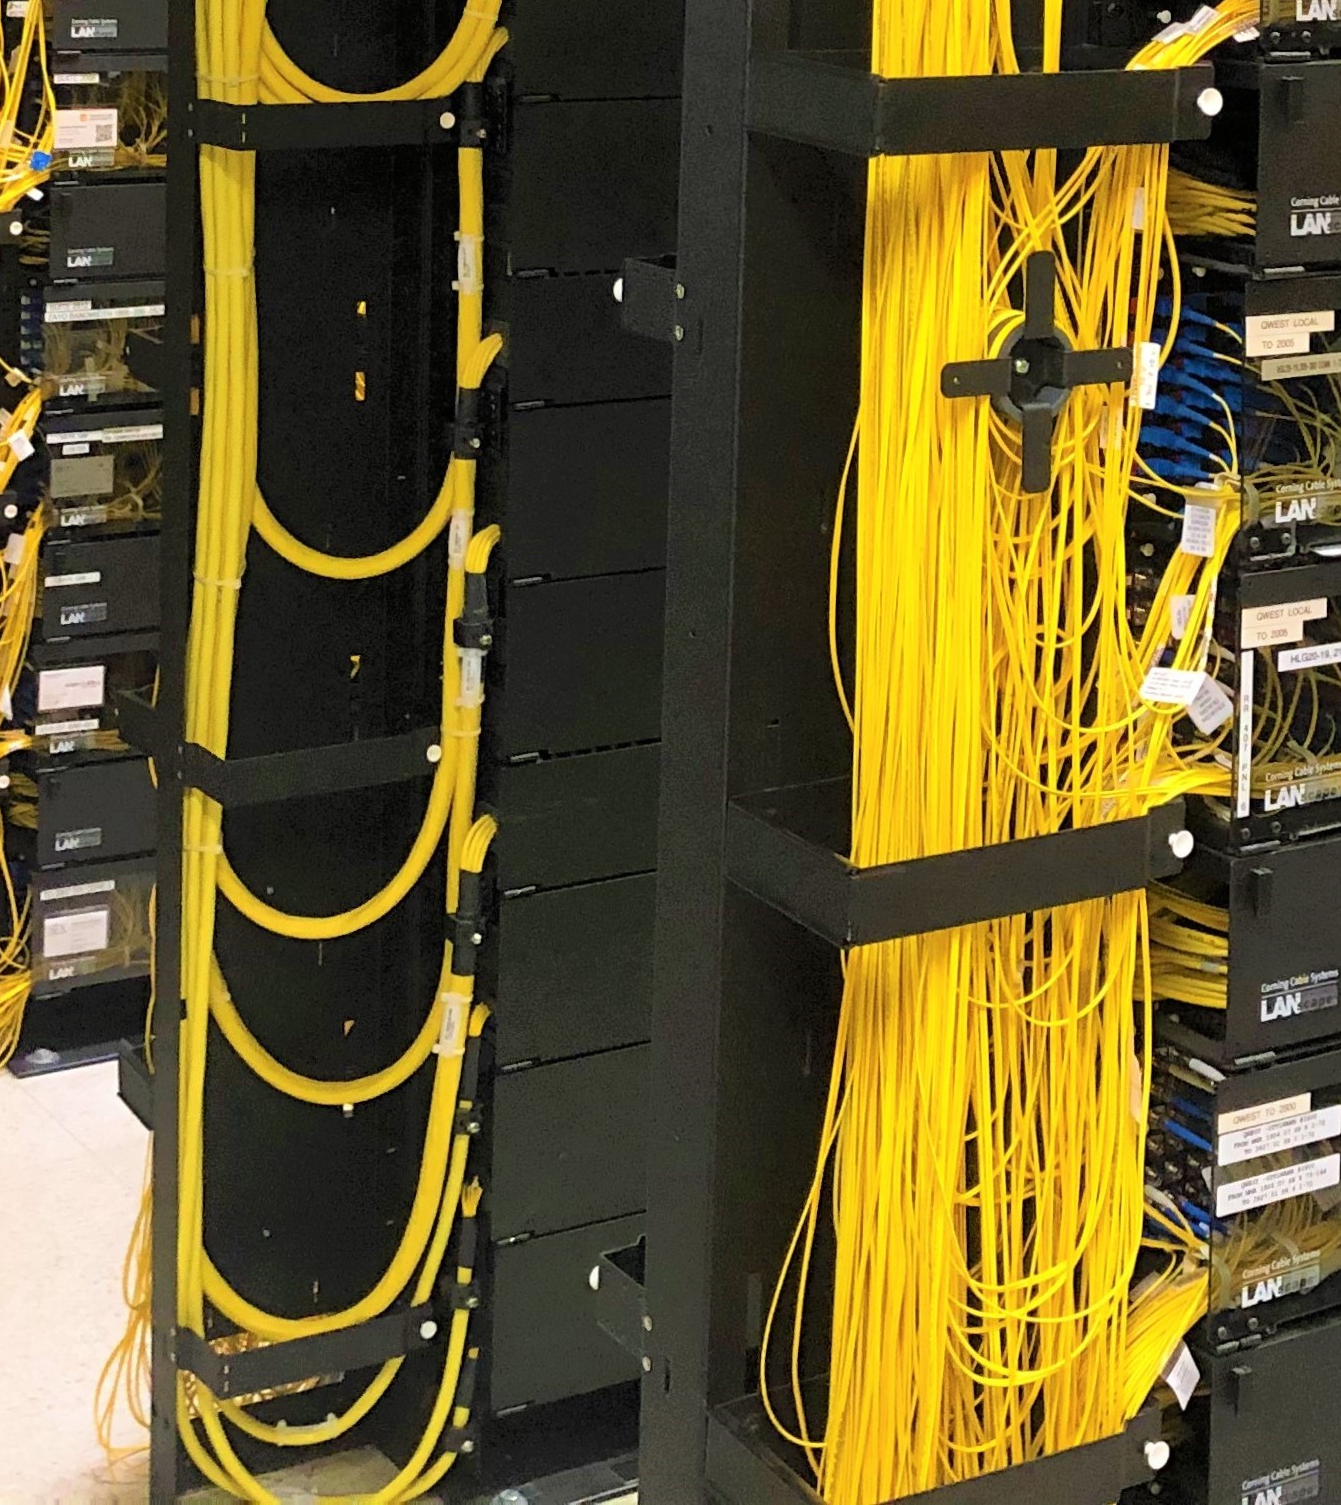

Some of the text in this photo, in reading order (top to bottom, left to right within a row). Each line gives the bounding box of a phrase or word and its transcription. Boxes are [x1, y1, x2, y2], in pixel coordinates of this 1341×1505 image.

[1290, 194, 1319, 208] Corning
[1320, 194, 1340, 205] Cable
[1293, 317, 1319, 328] LOCAL
[1261, 339, 1274, 349] TO
[1275, 482, 1304, 494] Corning
[1305, 480, 1326, 491] Cable
[1256, 606, 1313, 621] QWEST LOCAL
[1256, 630, 1268, 641] TO
[1265, 770, 1293, 782] Corning
[1294, 765, 1314, 777] Cable
[1261, 969, 1340, 993] Corning Cable Systems
[1233, 1111, 1260, 1125] QWEST
[1266, 1107, 1276, 1117] TO
[1242, 1250, 1321, 1280] Corning Cable Systems
[1242, 1458, 1320, 1491] Corning Cable Systems
